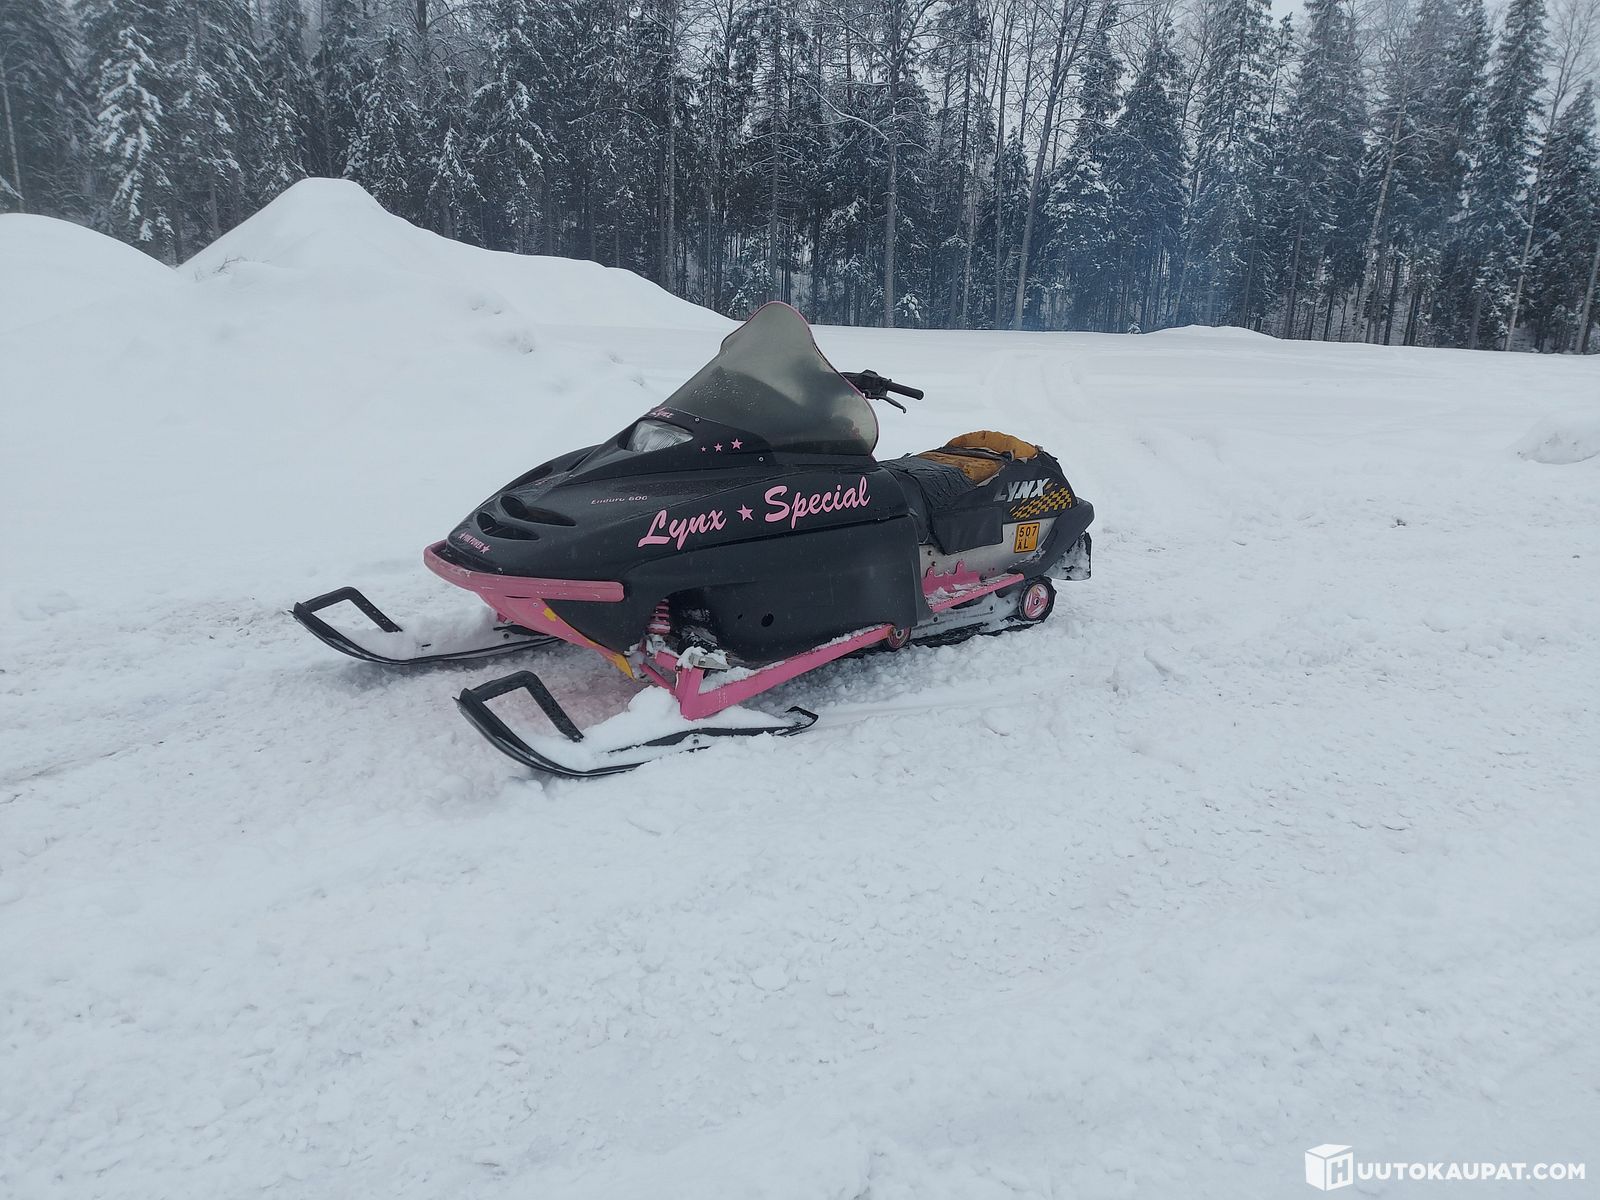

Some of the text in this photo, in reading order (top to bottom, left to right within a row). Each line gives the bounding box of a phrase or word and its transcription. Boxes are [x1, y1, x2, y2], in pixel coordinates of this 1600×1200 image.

[637, 476, 871, 550] Lynx Special
[1019, 526, 1037, 537] 507
